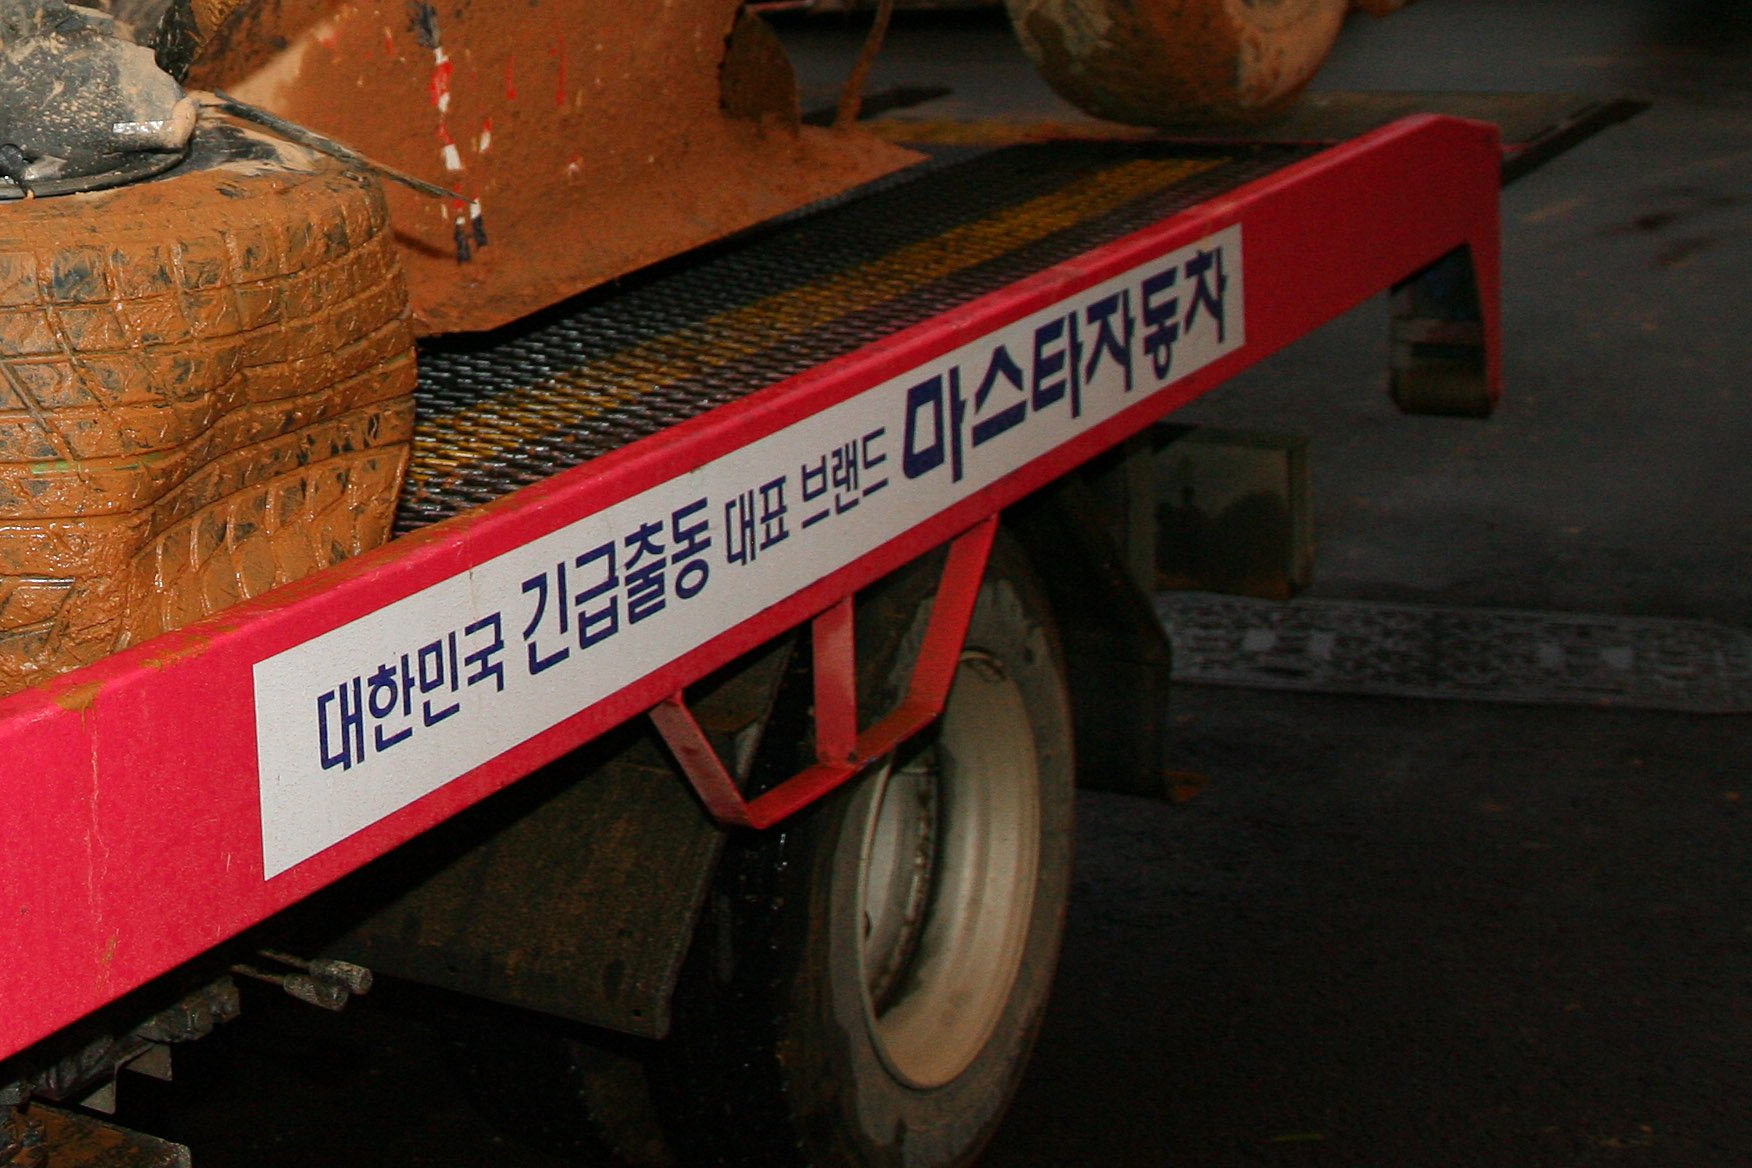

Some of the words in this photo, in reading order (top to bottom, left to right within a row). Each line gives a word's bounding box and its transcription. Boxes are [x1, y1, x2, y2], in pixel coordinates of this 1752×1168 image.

[316, 611, 506, 772] 대한민국
[521, 497, 713, 676] 긴급출동
[724, 475, 790, 567] 대표
[801, 427, 890, 529] 브랜드
[902, 246, 1228, 484] 마스타자동차
